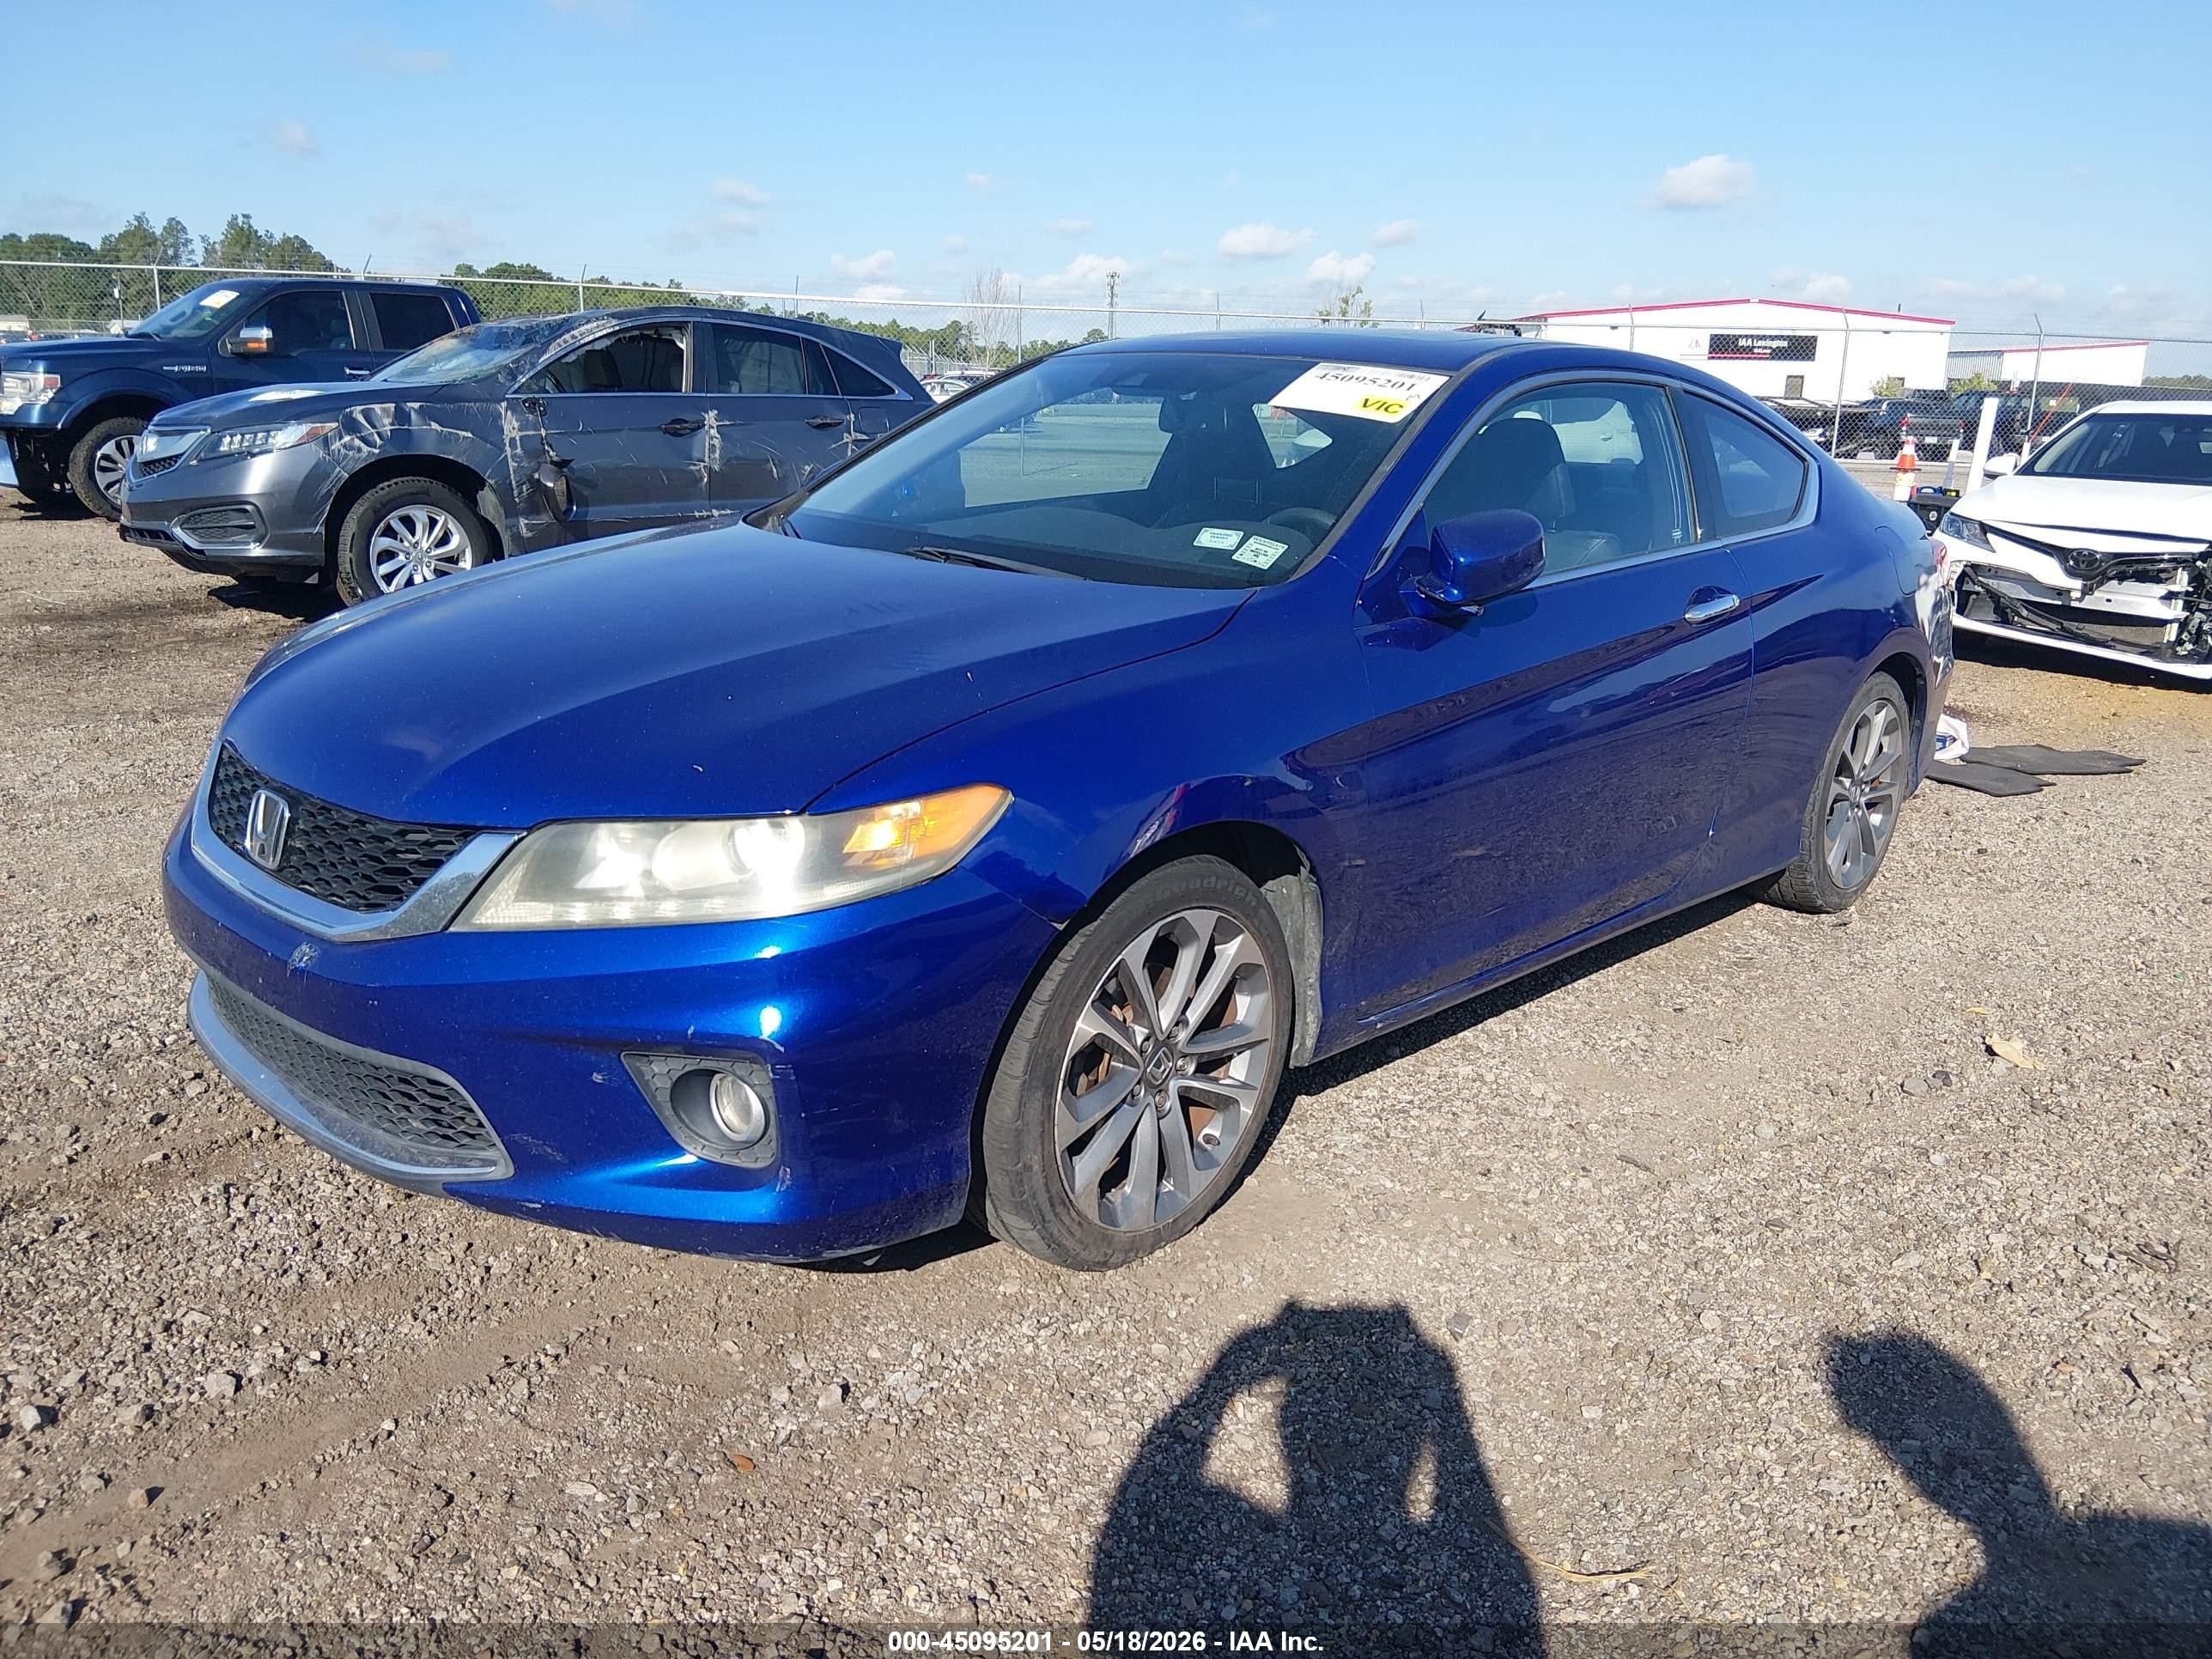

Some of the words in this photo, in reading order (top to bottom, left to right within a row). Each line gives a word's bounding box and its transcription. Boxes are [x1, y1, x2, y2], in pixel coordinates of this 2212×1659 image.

[1739, 338, 1753, 347] IAA
[1753, 338, 1788, 349] Lexington
[1315, 372, 1417, 391] 45095201
[1362, 398, 1404, 414] VIC
